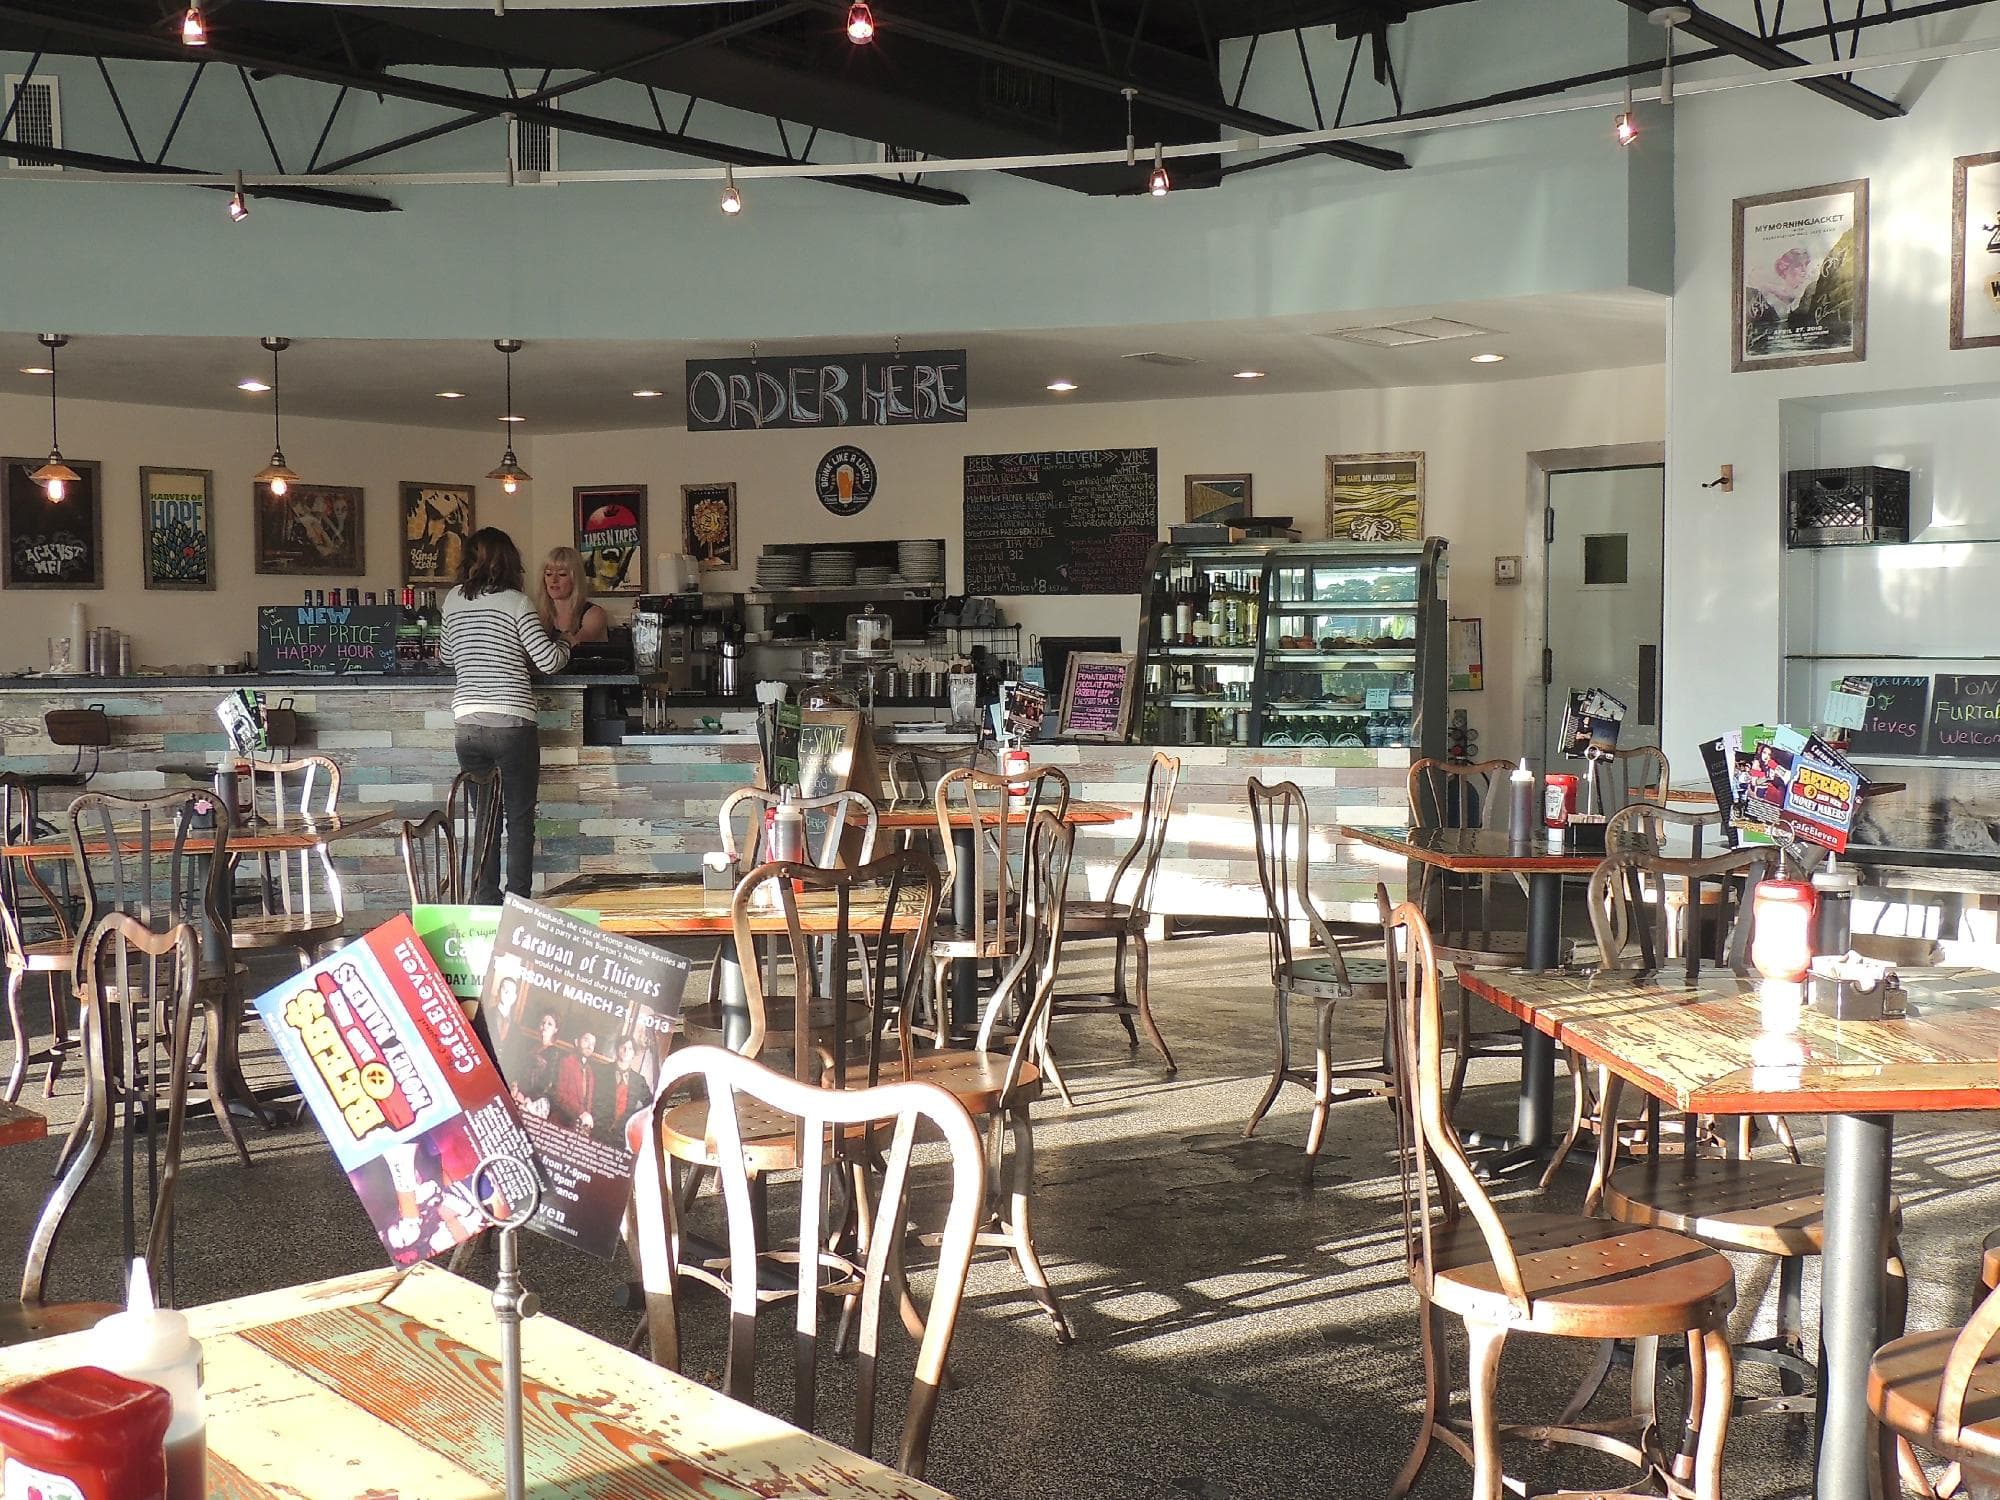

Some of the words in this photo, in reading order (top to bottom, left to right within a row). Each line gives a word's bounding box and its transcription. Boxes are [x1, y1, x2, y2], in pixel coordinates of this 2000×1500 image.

[690, 364, 849, 429] ORDER
[862, 360, 966, 426] HERE
[821, 462, 833, 488] DRINK
[831, 452, 849, 465] LIKE
[850, 454, 857, 463] A
[855, 458, 871, 485] LOCAL
[968, 456, 993, 469] BEER
[1019, 454, 1051, 466] CAFE
[1055, 451, 1098, 464] ELEVEN
[1120, 449, 1149, 463] WINE
[150, 492, 191, 501] HARVEST
[191, 493, 203, 501] OF
[151, 500, 203, 532] HOPE
[583, 531, 608, 547] TAPES
[606, 529, 615, 547] N
[613, 527, 639, 545] TAPES
[25, 543, 84, 564] AGAINST
[410, 548, 440, 562] Kings
[1008, 549, 1024, 561] 312
[34, 559, 61, 576] ME!
[297, 607, 350, 625] NEW
[277, 644, 327, 660] HAPPY
[337, 644, 375, 660] HOUR
[951, 677, 975, 686] TIPS
[1950, 675, 2000, 696] TON
[1792, 794, 1818, 811] MONEY
[1817, 802, 1847, 820] MAKERS
[1791, 819, 1839, 845] CafeEleven
[512, 924, 575, 967] Caravan
[579, 953, 600, 974] of
[603, 957, 661, 998] Thieves
[623, 942, 637, 952] and
[637, 947, 650, 957] the
[650, 951, 676, 967] Beatles
[676, 960, 687, 970] all
[533, 957, 554, 970] would
[553, 965, 563, 974] be
[562, 969, 575, 979] the
[575, 973, 593, 986] band
[592, 980, 609, 993] they
[332, 963, 397, 1048] MAKERS
[394, 942, 475, 1074] CafeEleven
[562, 984, 613, 1014] MARCH
[636, 1012, 670, 1034] 2013
[382, 1040, 433, 1112] MONEY
[542, 1155, 563, 1172] from
